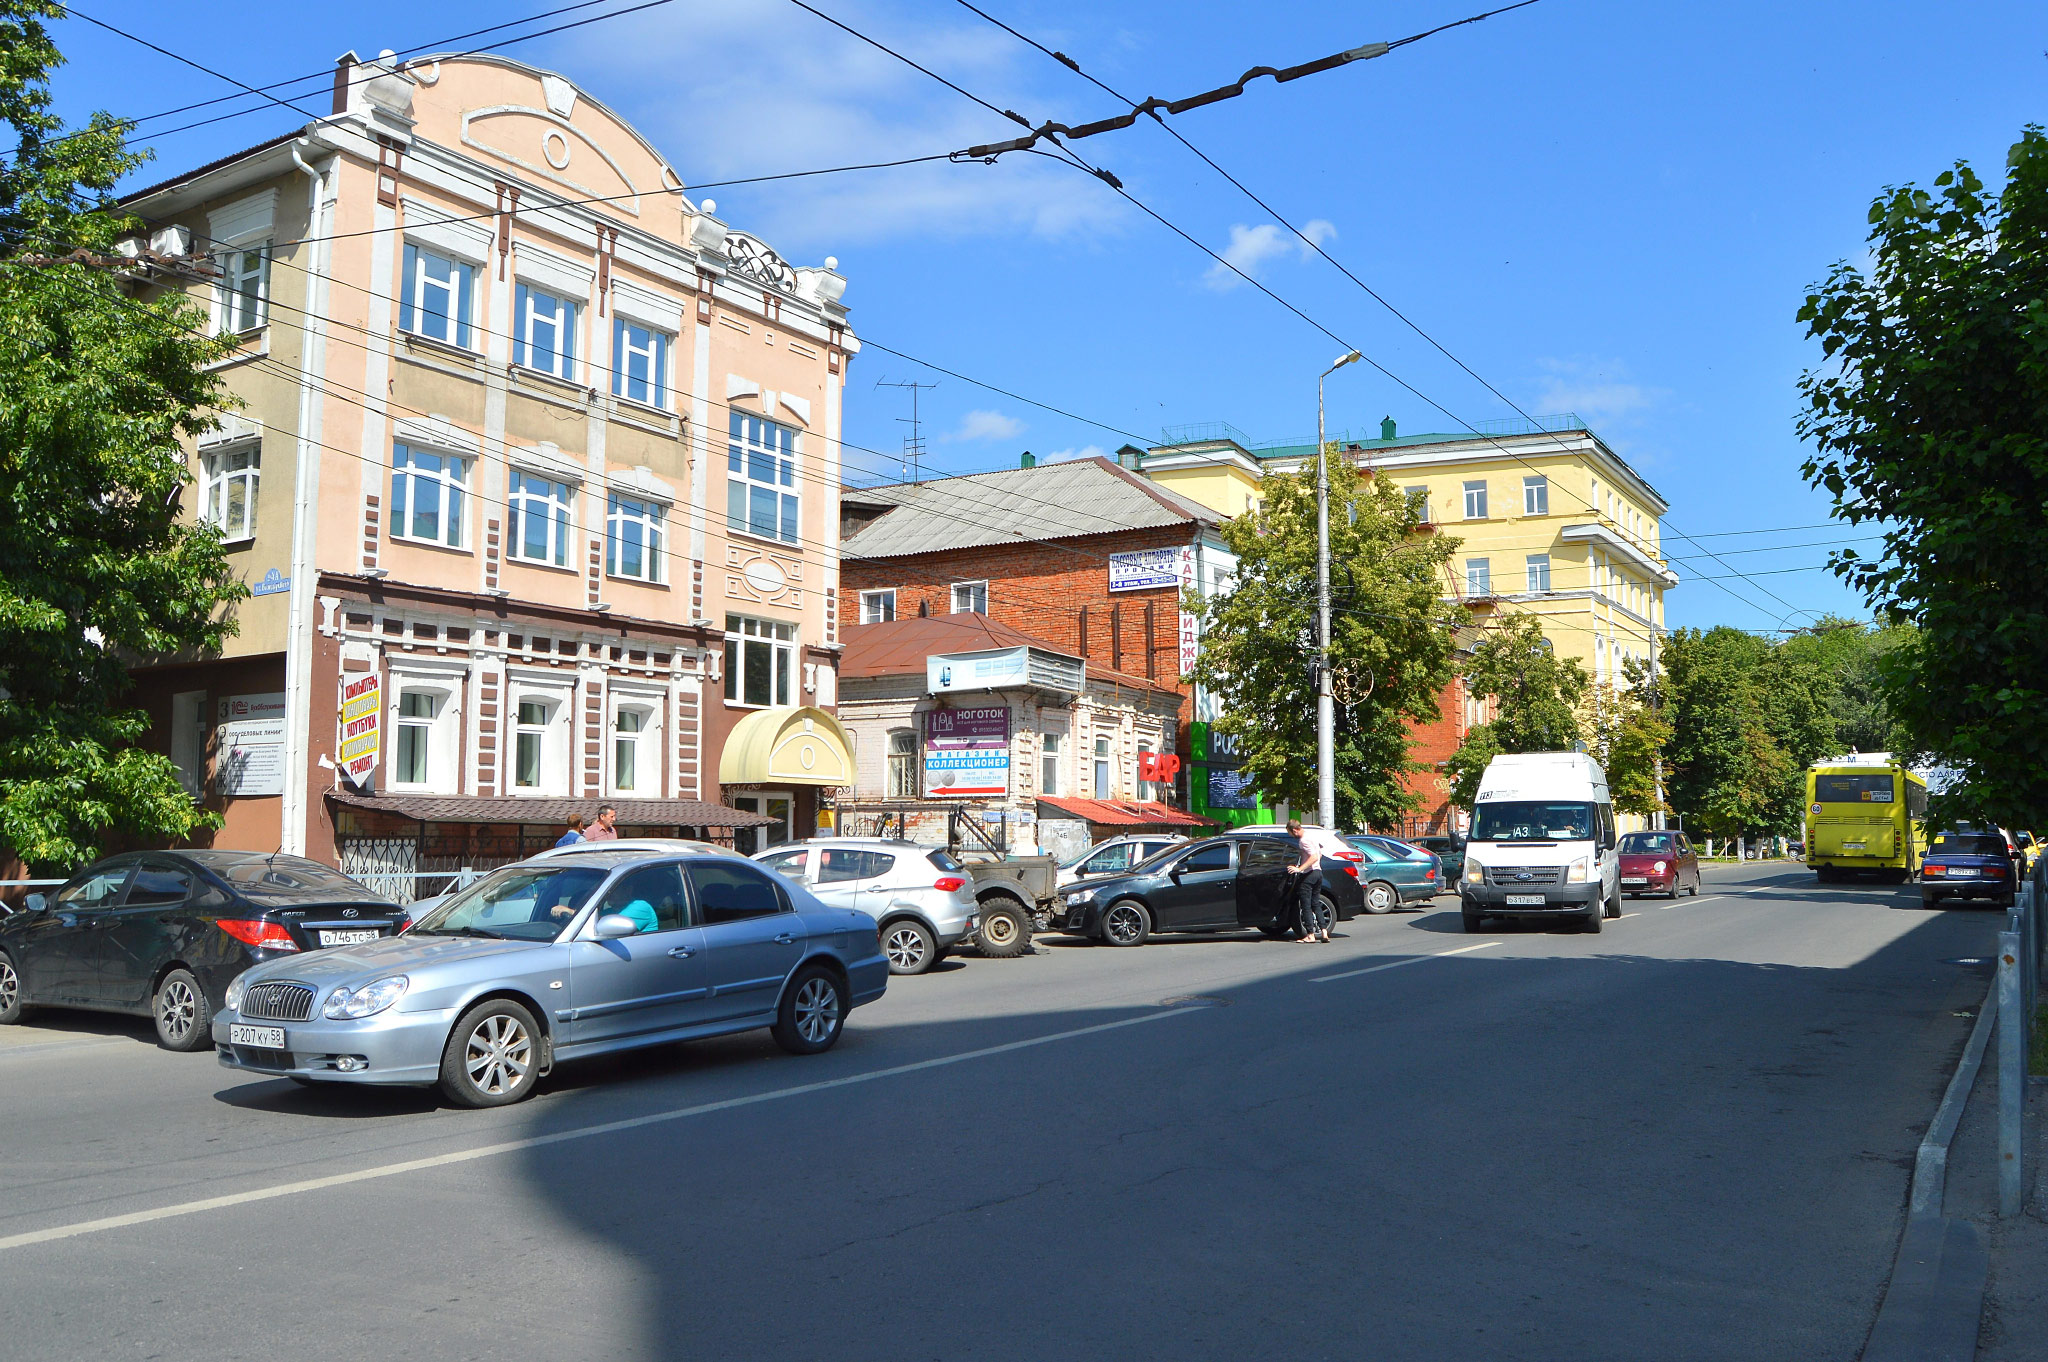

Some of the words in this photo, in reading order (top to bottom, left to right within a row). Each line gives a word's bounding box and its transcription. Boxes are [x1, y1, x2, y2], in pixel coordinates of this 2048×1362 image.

[1115, 563, 1173, 575] ПРОДАЖА
[1182, 550, 1196, 672] КАРИДЖИ
[345, 673, 379, 700] КОМПЬЮТЕРЫ
[956, 709, 1004, 720] НОГОТОК
[346, 714, 377, 738] НОУТБУКИ
[349, 754, 374, 776] РЕМОНТ
[927, 758, 1007, 769] КОЛЛЕКЦИОНЕР
[936, 750, 1001, 758] МАГАЗИН
[1139, 751, 1180, 784] БАР
